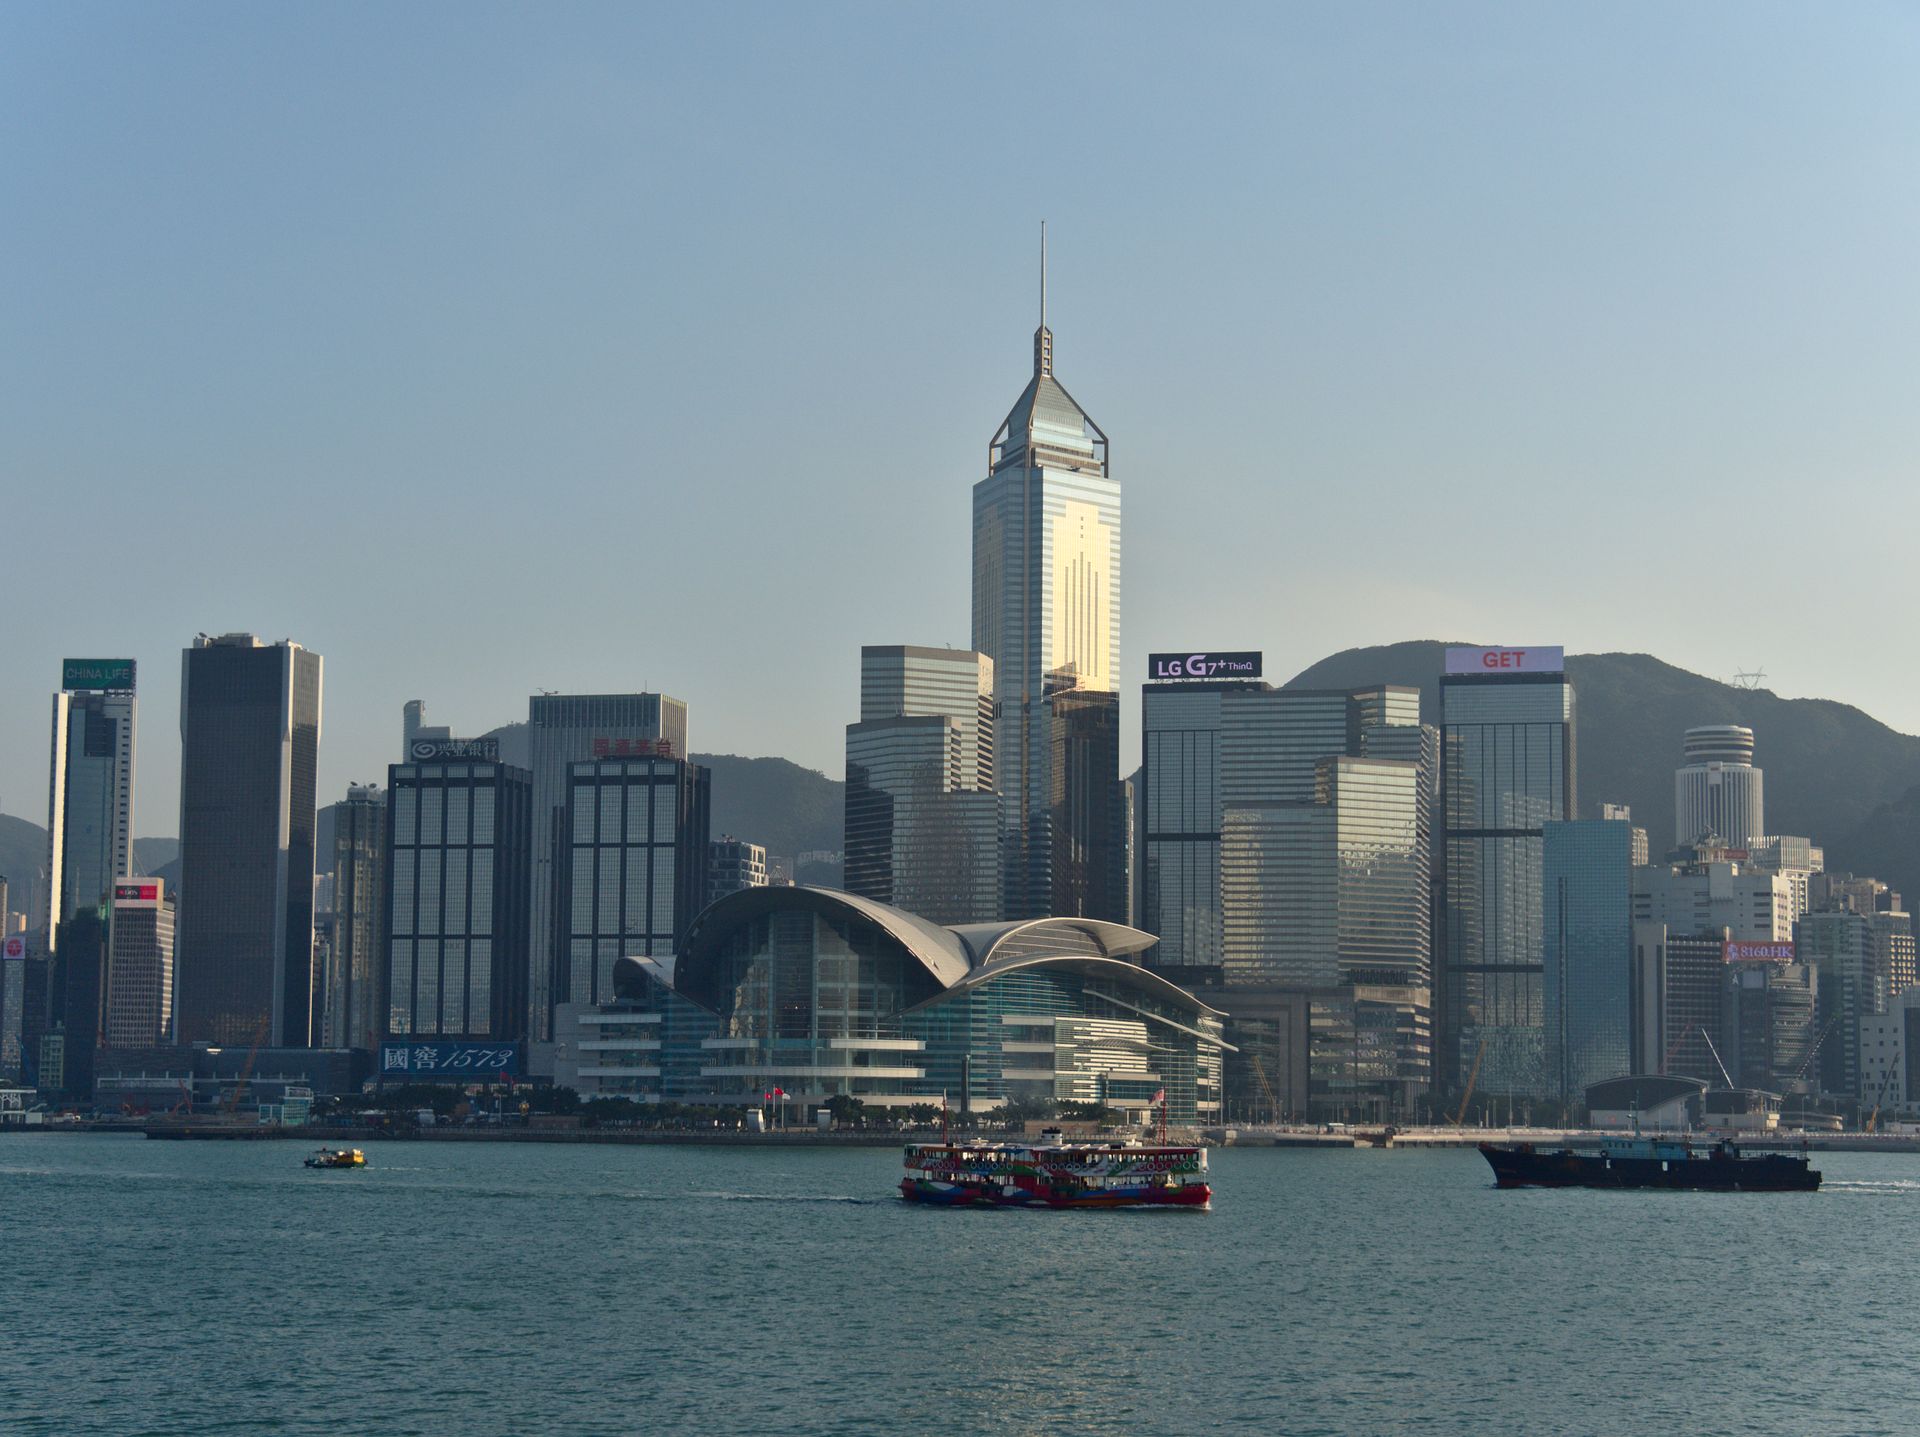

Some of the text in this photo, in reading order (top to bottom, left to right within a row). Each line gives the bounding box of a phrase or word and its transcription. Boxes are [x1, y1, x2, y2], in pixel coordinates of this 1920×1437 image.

[1483, 652, 1525, 667] GET
[66, 668, 129, 679] CHINA LIFE
[1158, 661, 1182, 676] LG
[1228, 662, 1252, 670] ThinQ
[1741, 946, 1793, 957] 8160.HK
